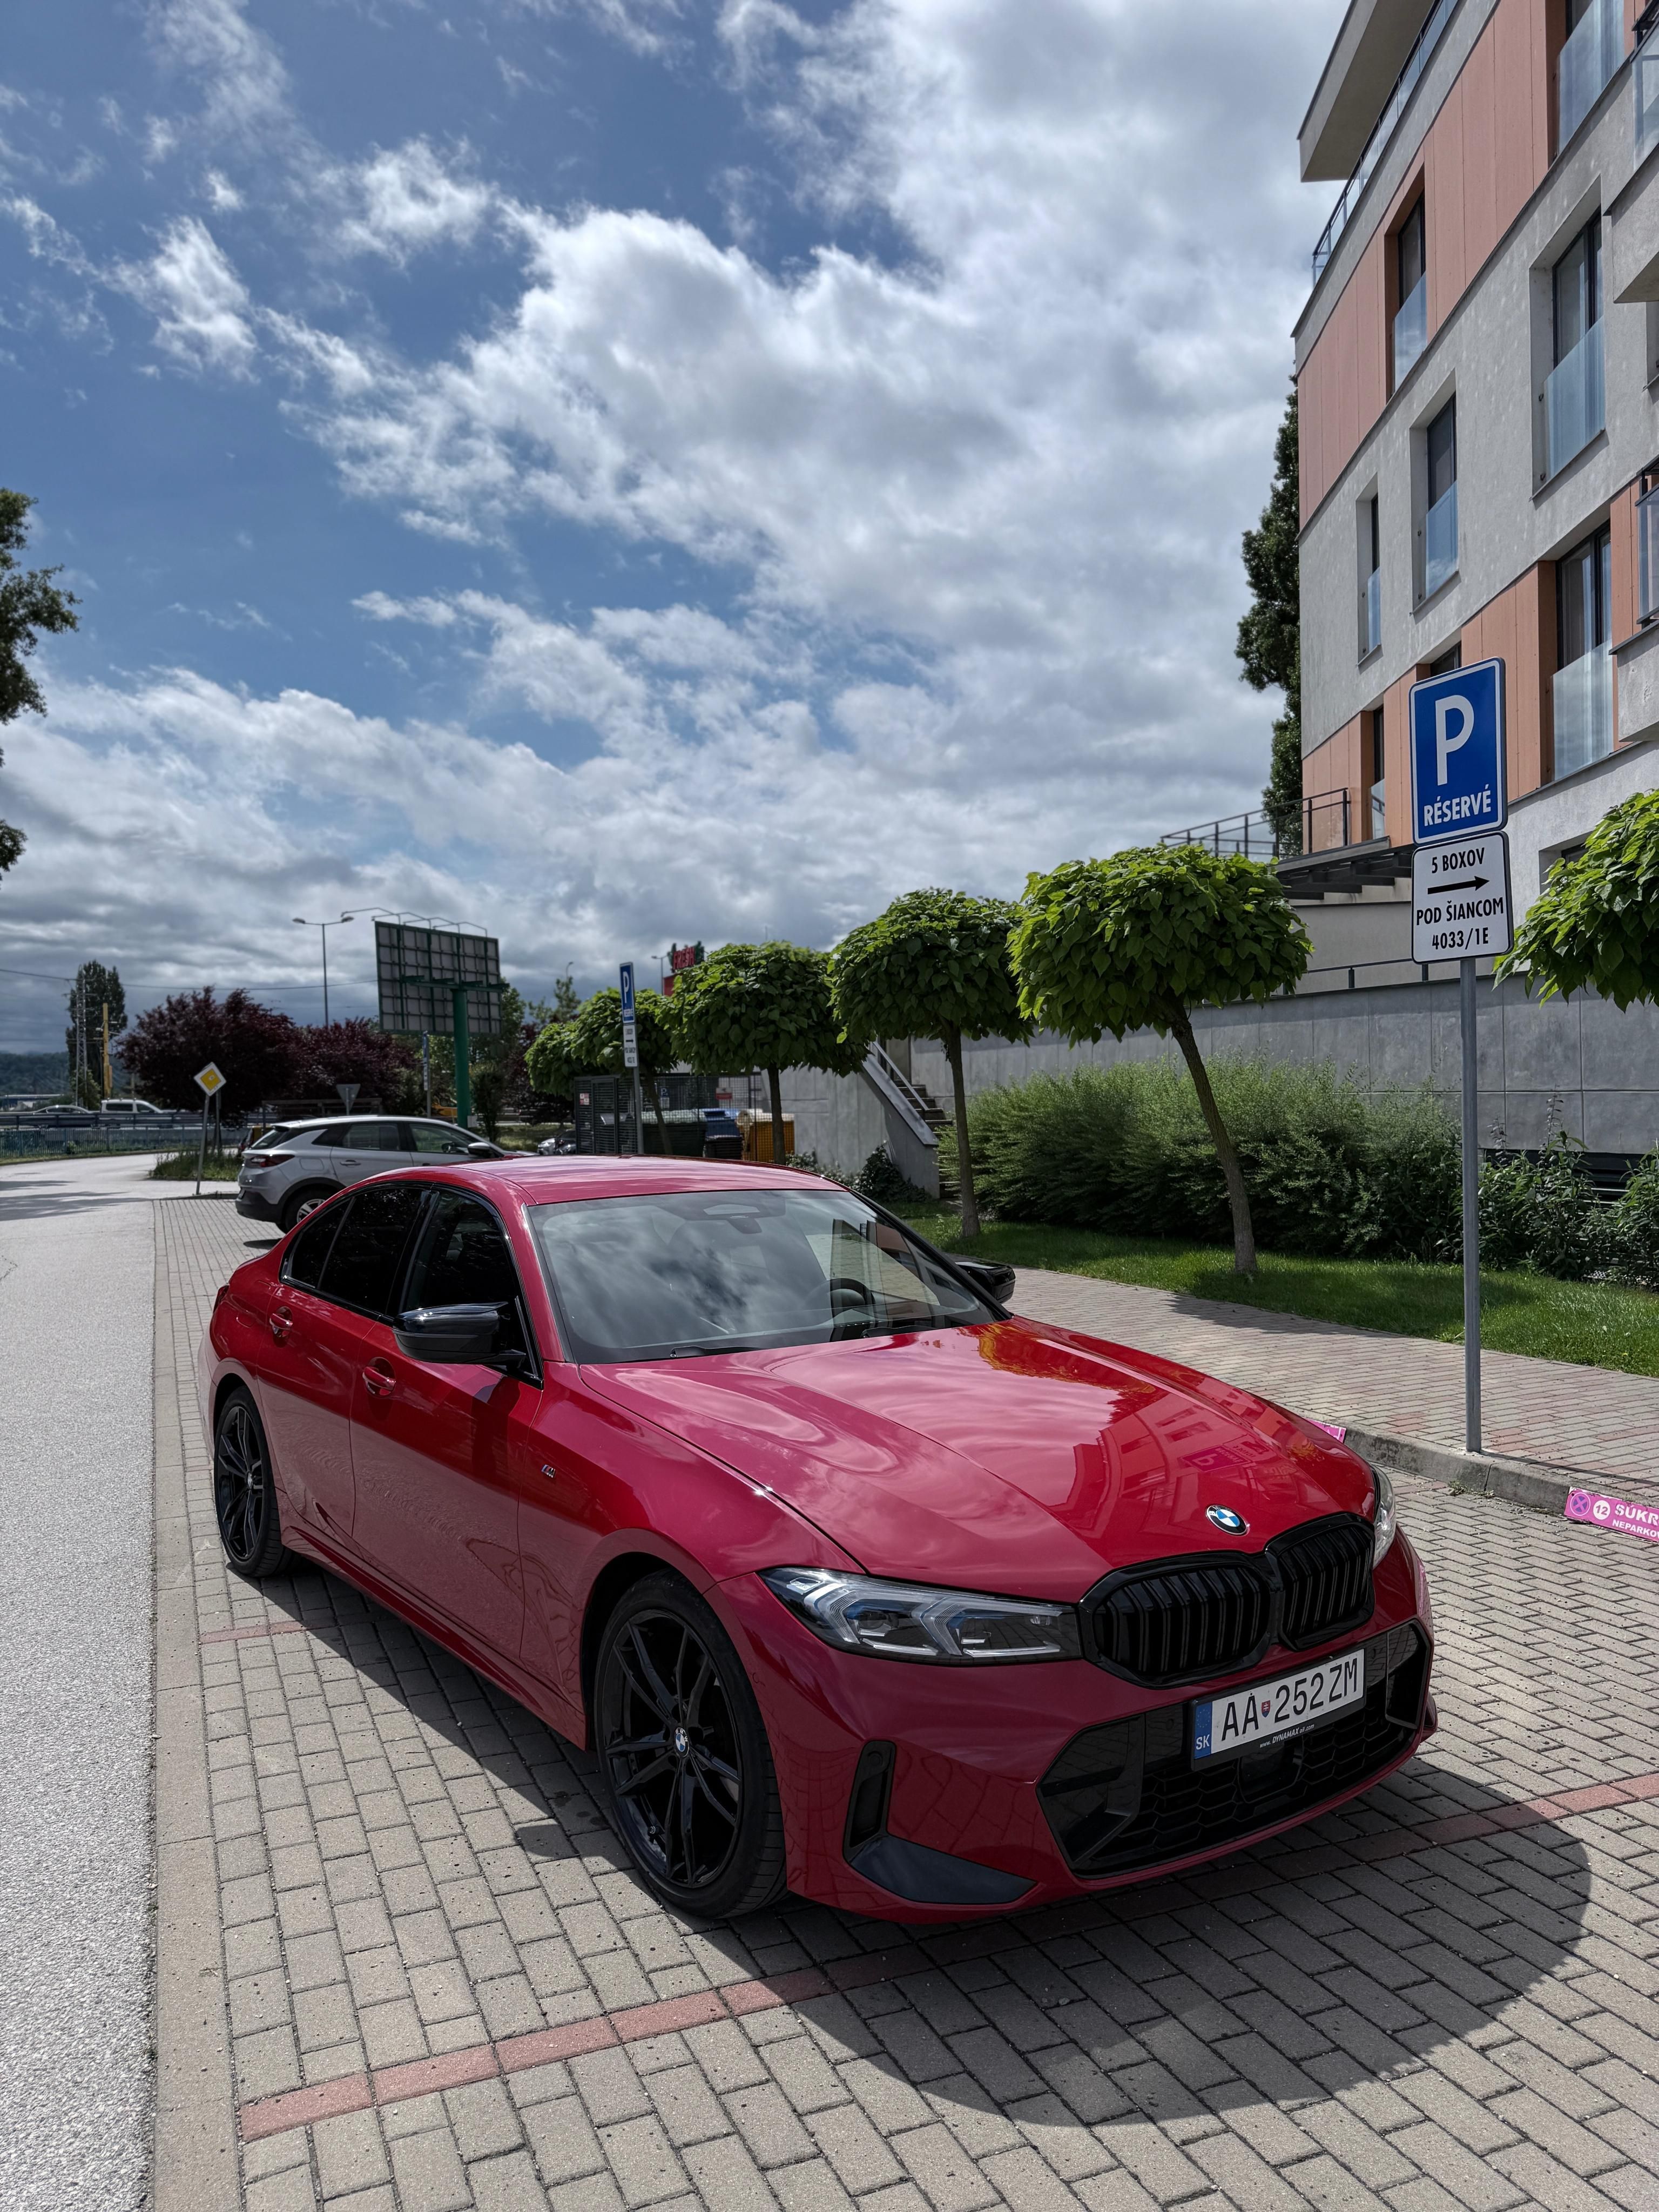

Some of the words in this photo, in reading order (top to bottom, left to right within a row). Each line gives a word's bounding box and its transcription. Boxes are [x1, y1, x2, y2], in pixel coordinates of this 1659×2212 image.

[1435, 694, 1474, 786] P
[1424, 784, 1491, 827] RÉSERVÉ
[1432, 856, 1438, 874] 5
[1442, 847, 1485, 872] BOXOV
[1416, 907, 1442, 926] POD
[1446, 896, 1504, 922] ŠIANCOM
[1432, 927, 1489, 950] 4033/1E
[623, 971, 630, 1003] P
[1595, 1505, 1608, 1515] 12
[1615, 1503, 1659, 1526] SÚKR
[1612, 1519, 1659, 1539] NEPARKO
[1196, 1734, 1210, 1750] SK
